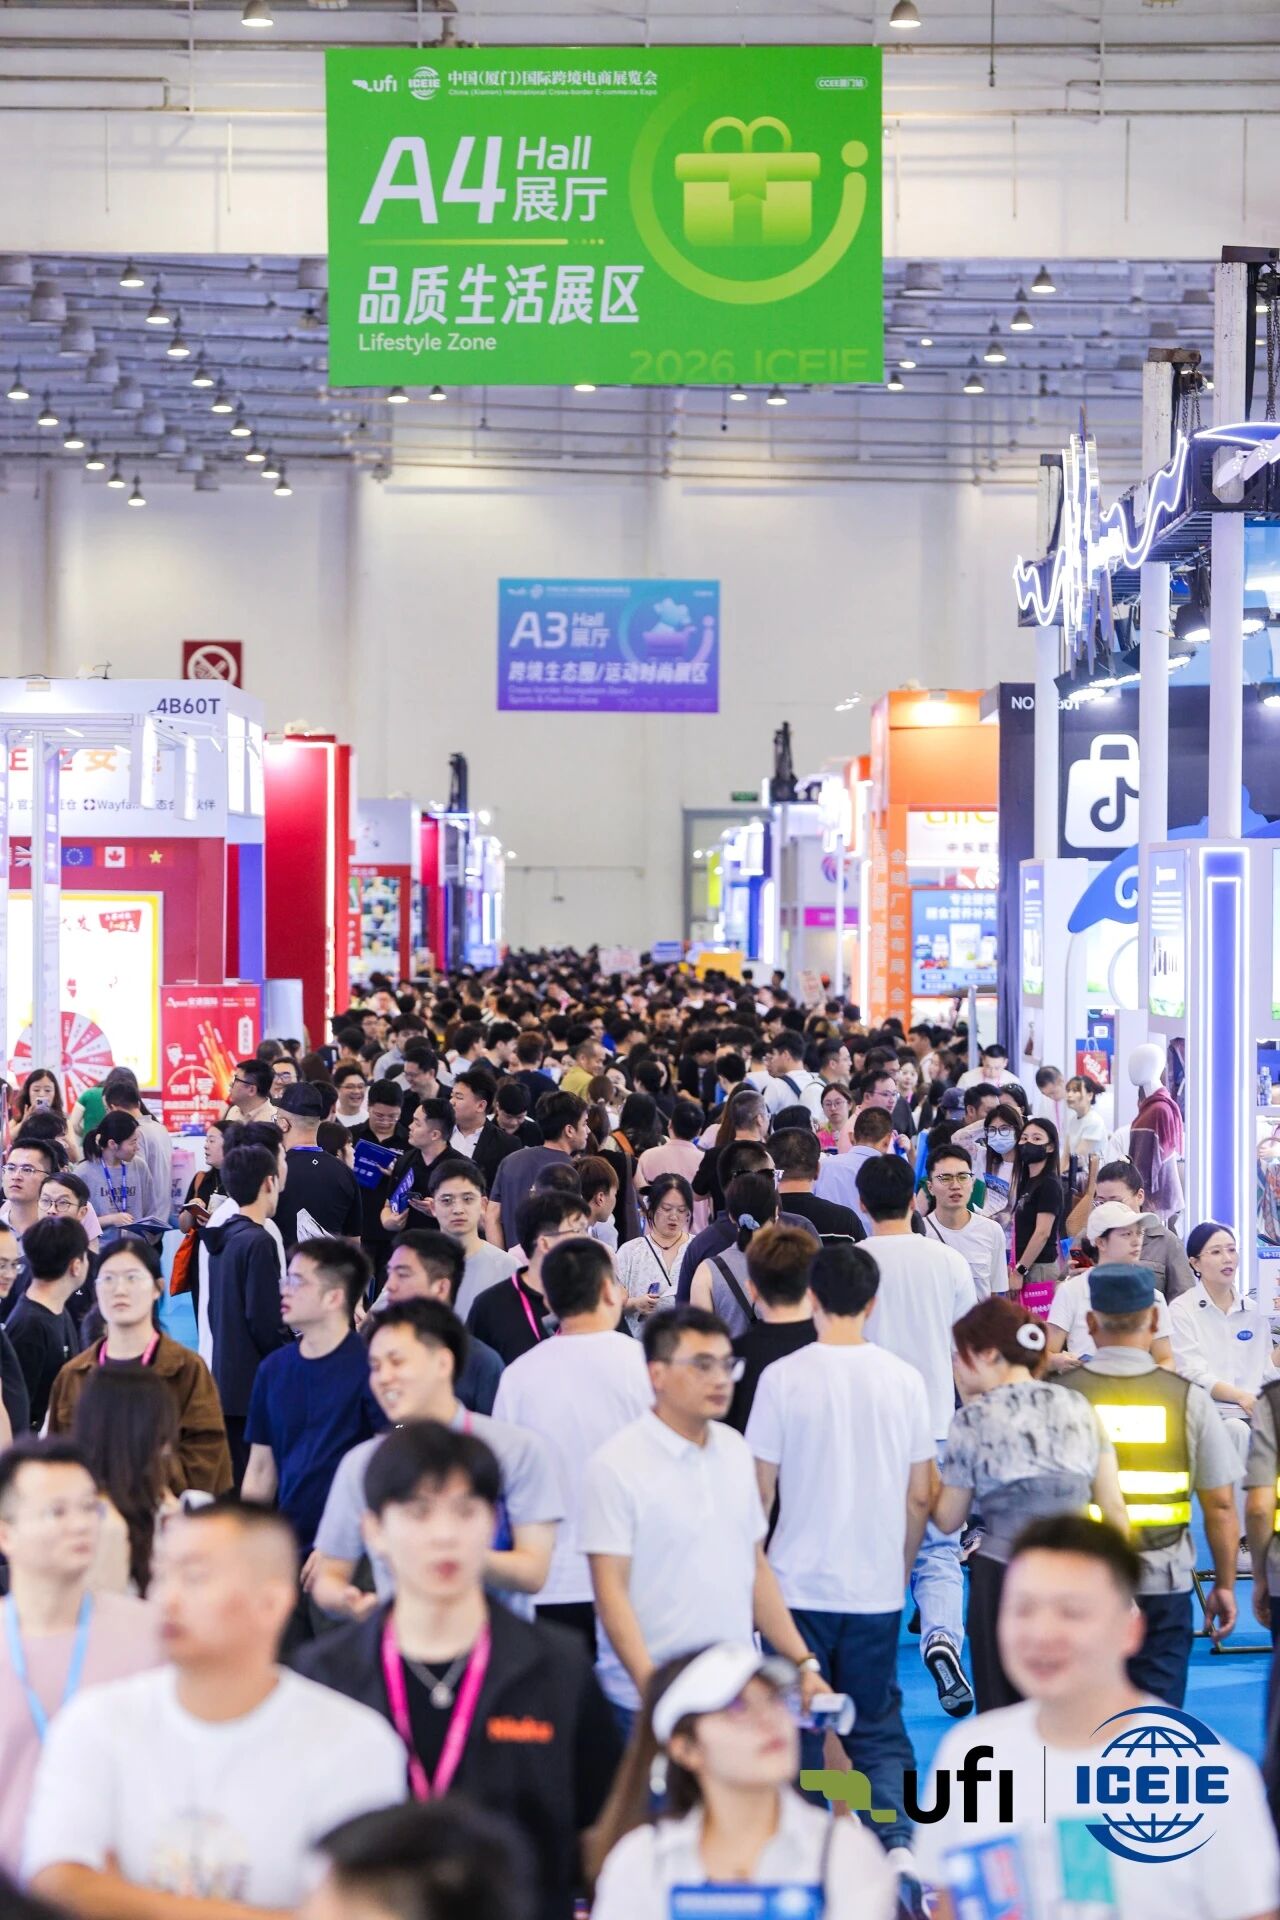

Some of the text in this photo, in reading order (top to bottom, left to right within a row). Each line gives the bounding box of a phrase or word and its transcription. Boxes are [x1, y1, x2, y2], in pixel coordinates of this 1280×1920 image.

[516, 135, 592, 171] Hall
[358, 136, 507, 224] A4
[512, 176, 608, 222] 展厅
[358, 263, 645, 326] 品质生活展区
[358, 332, 497, 355] Lifestyle Zone
[629, 348, 736, 382] 2026
[509, 610, 569, 649] A3
[571, 611, 605, 627] Hall
[570, 627, 610, 648] 展厅
[156, 698, 221, 715] 4B60T
